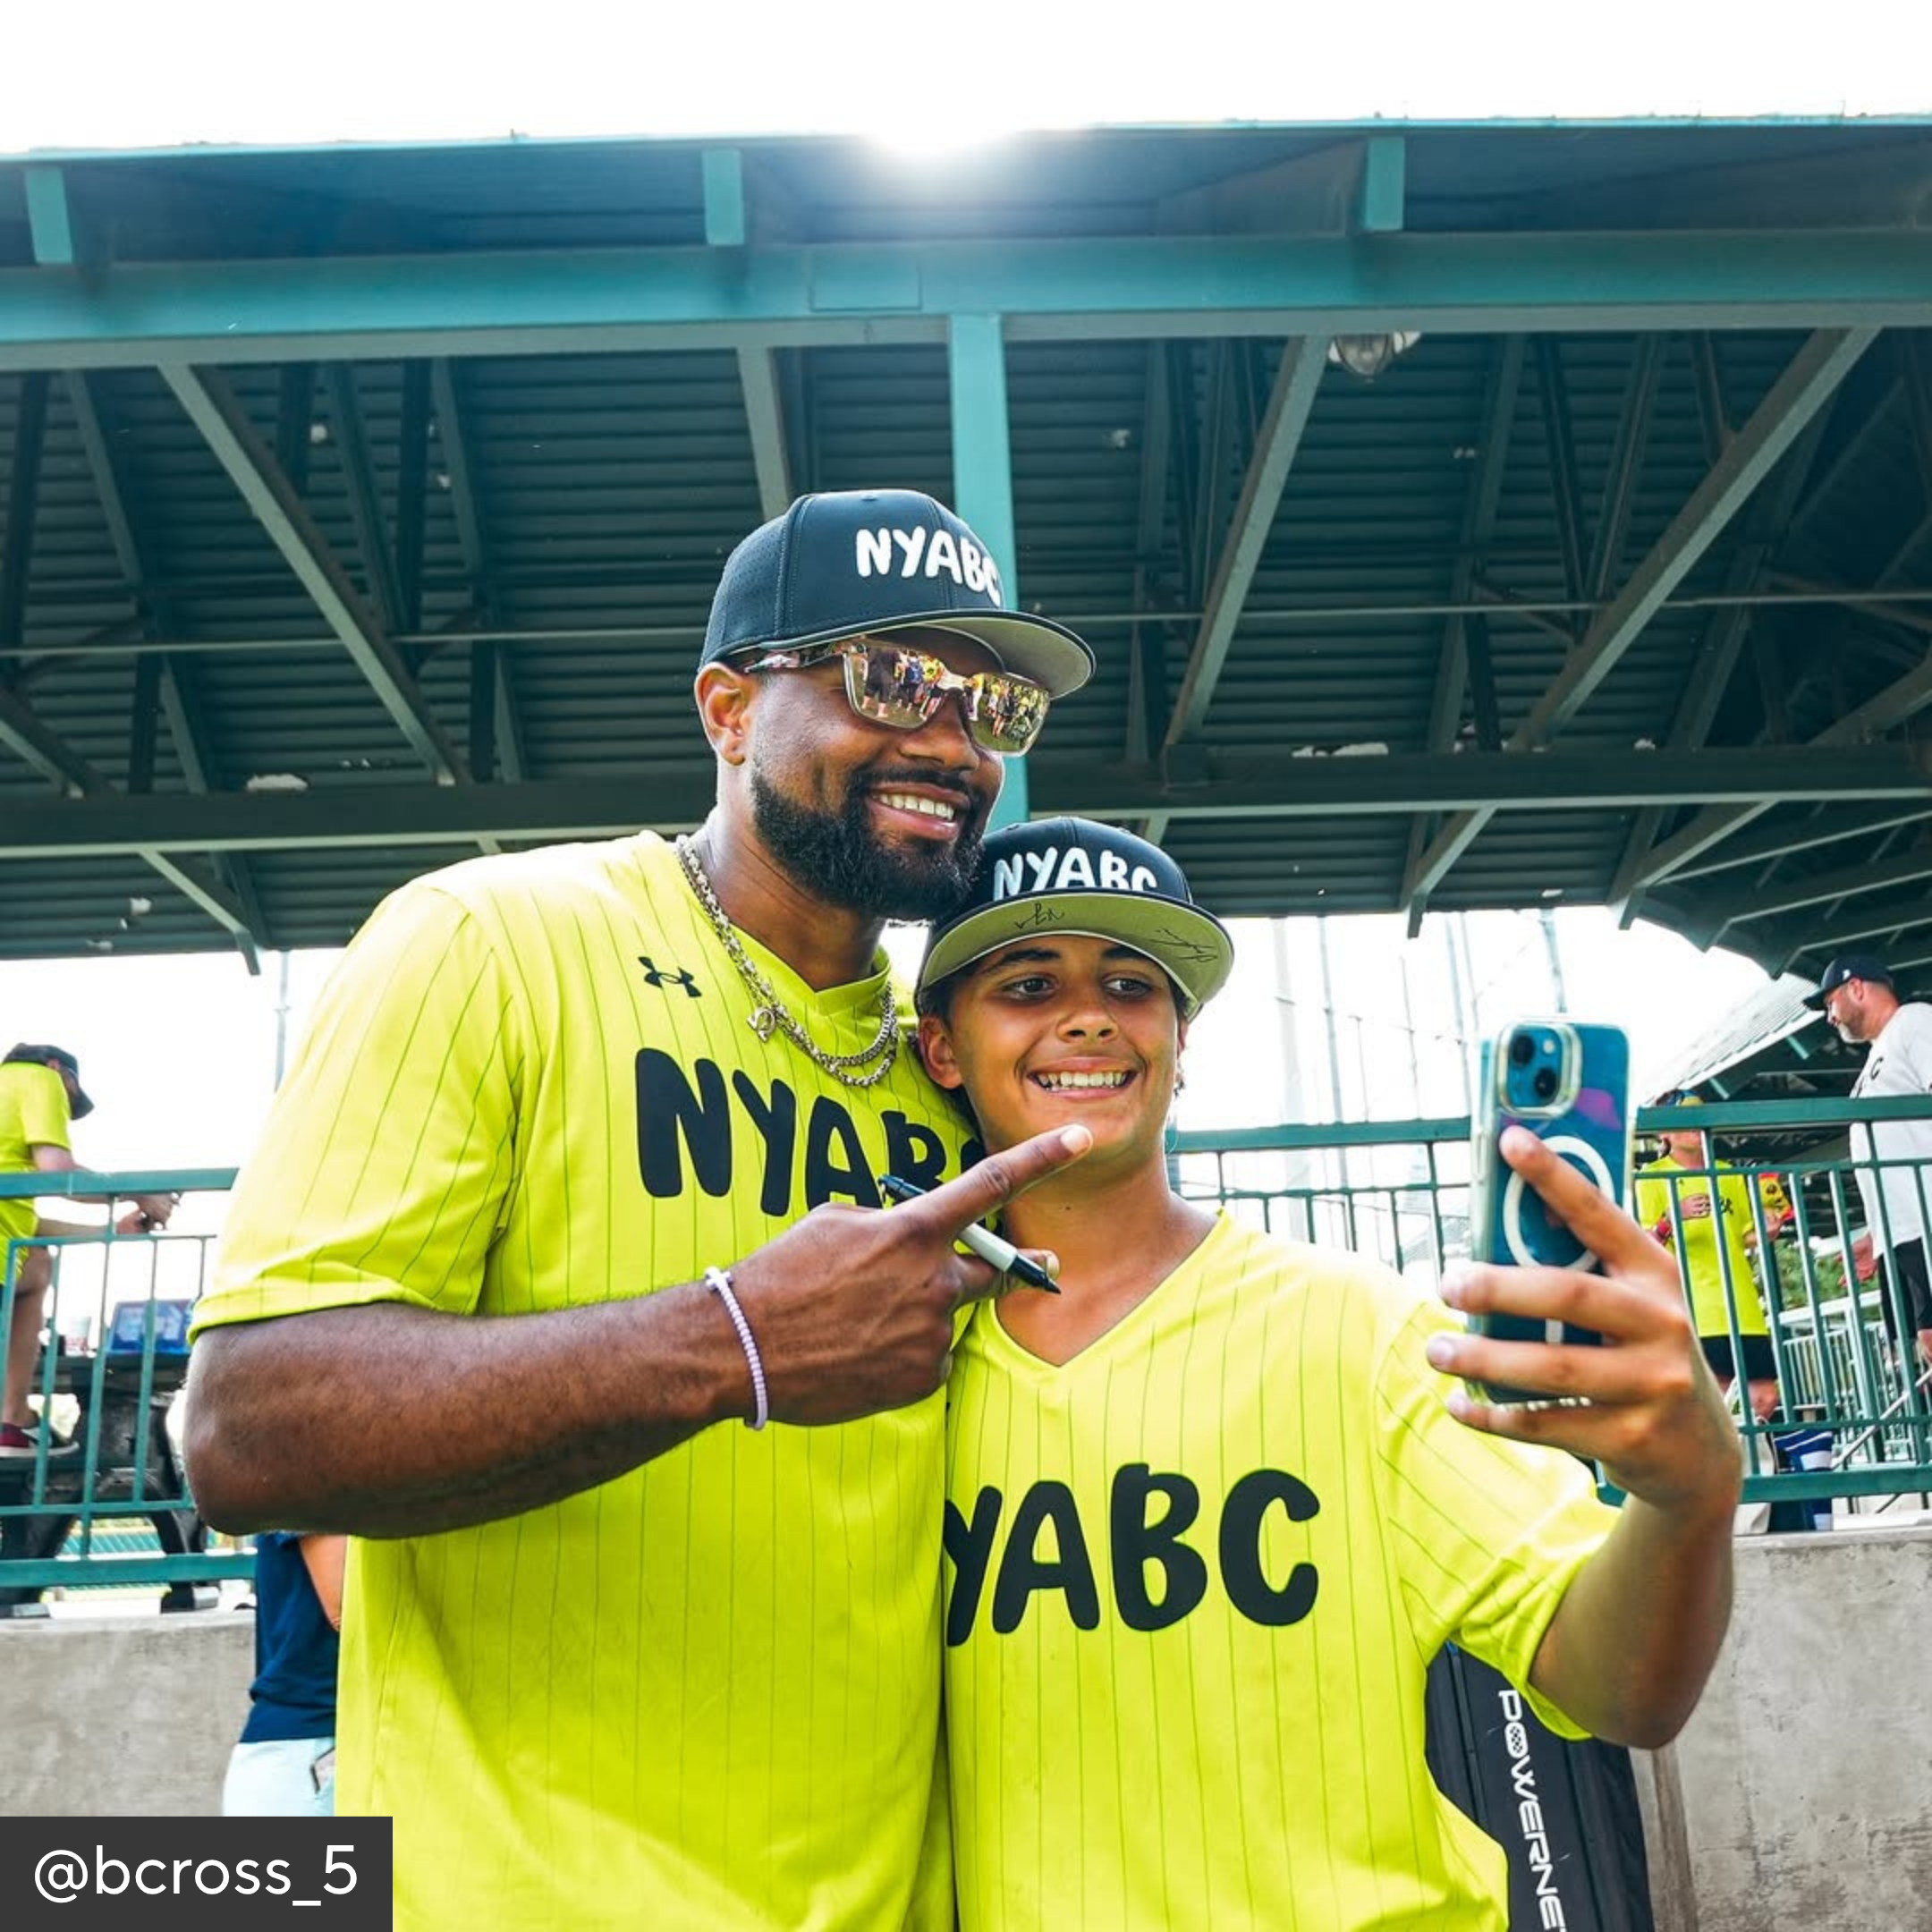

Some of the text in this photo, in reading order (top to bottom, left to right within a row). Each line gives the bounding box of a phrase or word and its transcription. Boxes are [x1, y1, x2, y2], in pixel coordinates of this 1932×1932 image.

[856, 526, 1001, 607] NYABC
[943, 1462, 1320, 1648] YABC
[1498, 1690, 1567, 1932] POWERNE
